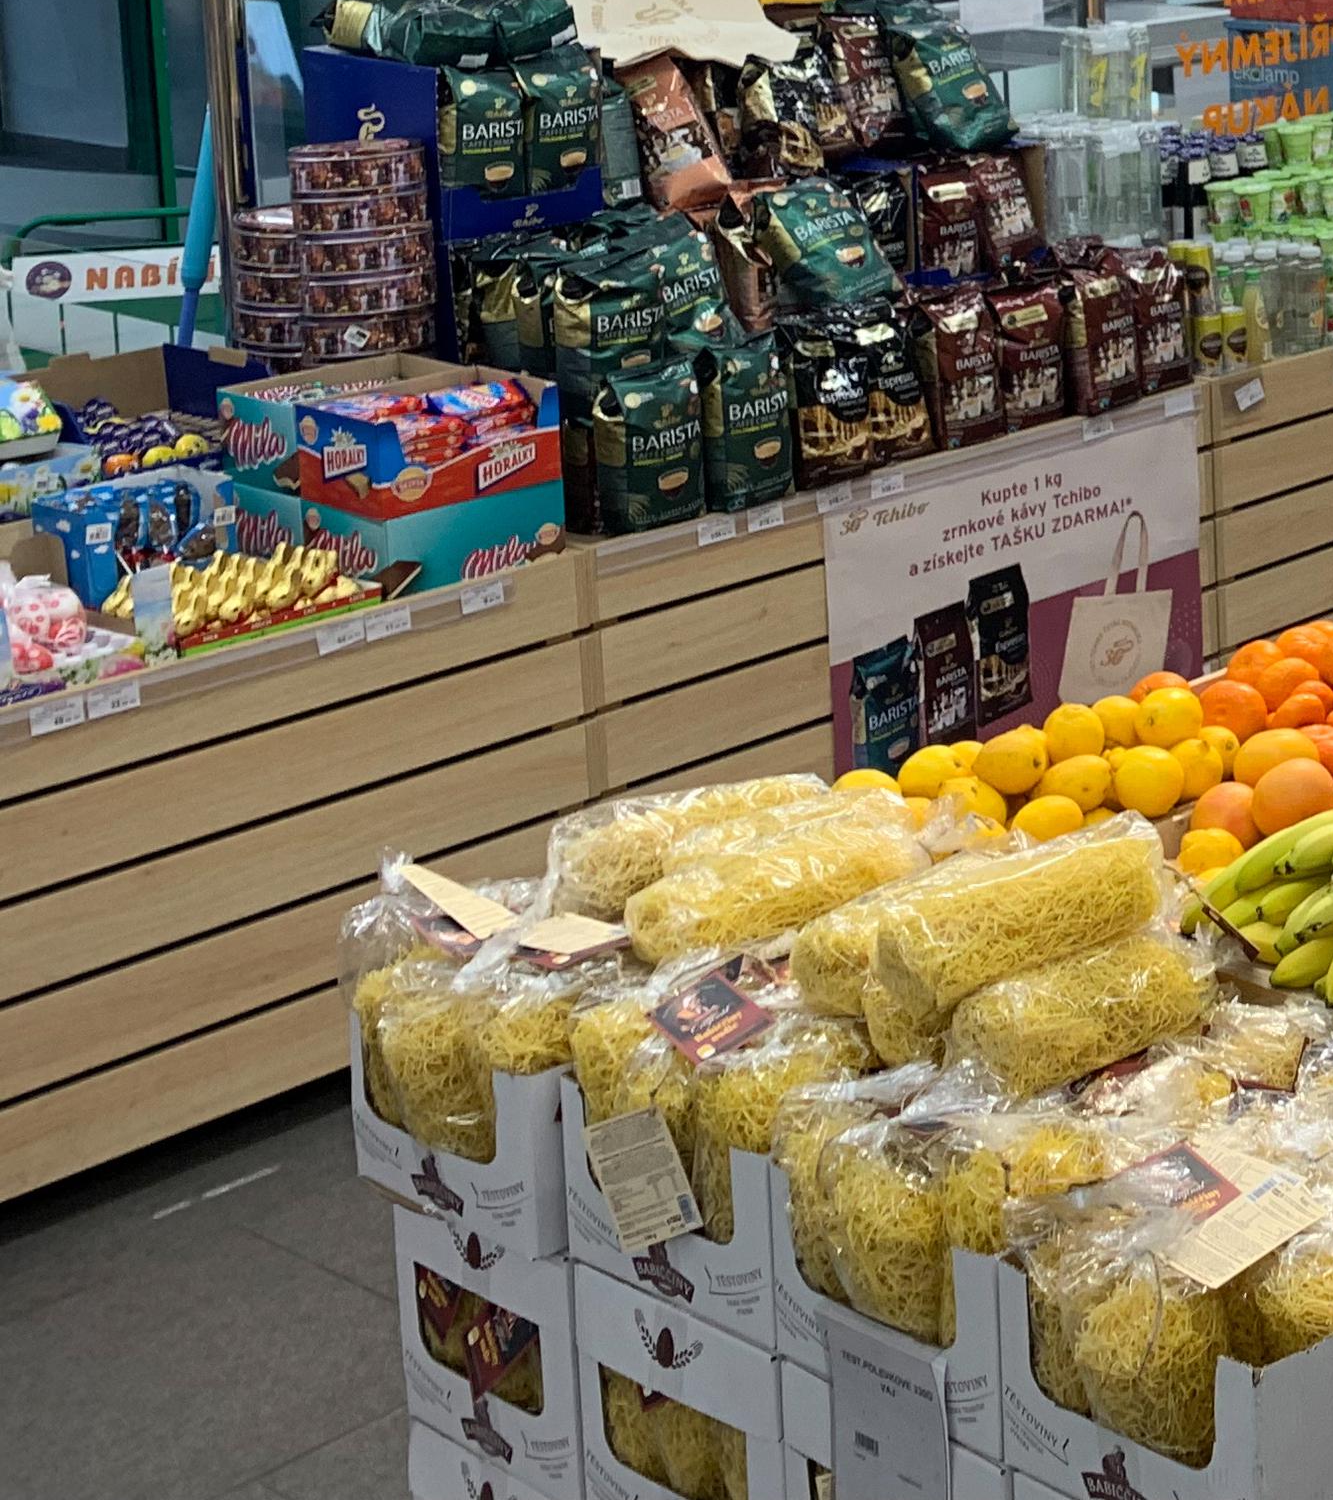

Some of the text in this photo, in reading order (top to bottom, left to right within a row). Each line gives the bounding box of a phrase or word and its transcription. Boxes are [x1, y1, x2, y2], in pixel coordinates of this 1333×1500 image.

[539, 104, 599, 129] BARISTA
[793, 208, 856, 243] BARISTA
[85, 255, 216, 291] NABÍÍ
[1101, 315, 1135, 334] BARISTA
[955, 353, 995, 372] BARISTA
[1019, 344, 1060, 363] BARISTA
[227, 417, 287, 471] Mila
[632, 420, 701, 452] BARISTA
[326, 451, 364, 473] HORALKY
[482, 449, 536, 483] HORALKY
[980, 471, 1063, 507] Kupte 1 kg
[873, 501, 930, 527] Tchibo
[942, 485, 1102, 543] zrnkové kávy Tchibo
[909, 565, 918, 577] a
[922, 544, 985, 571] získejte
[991, 521, 1046, 552] TAŠKU
[868, 699, 919, 730] BARISTA
